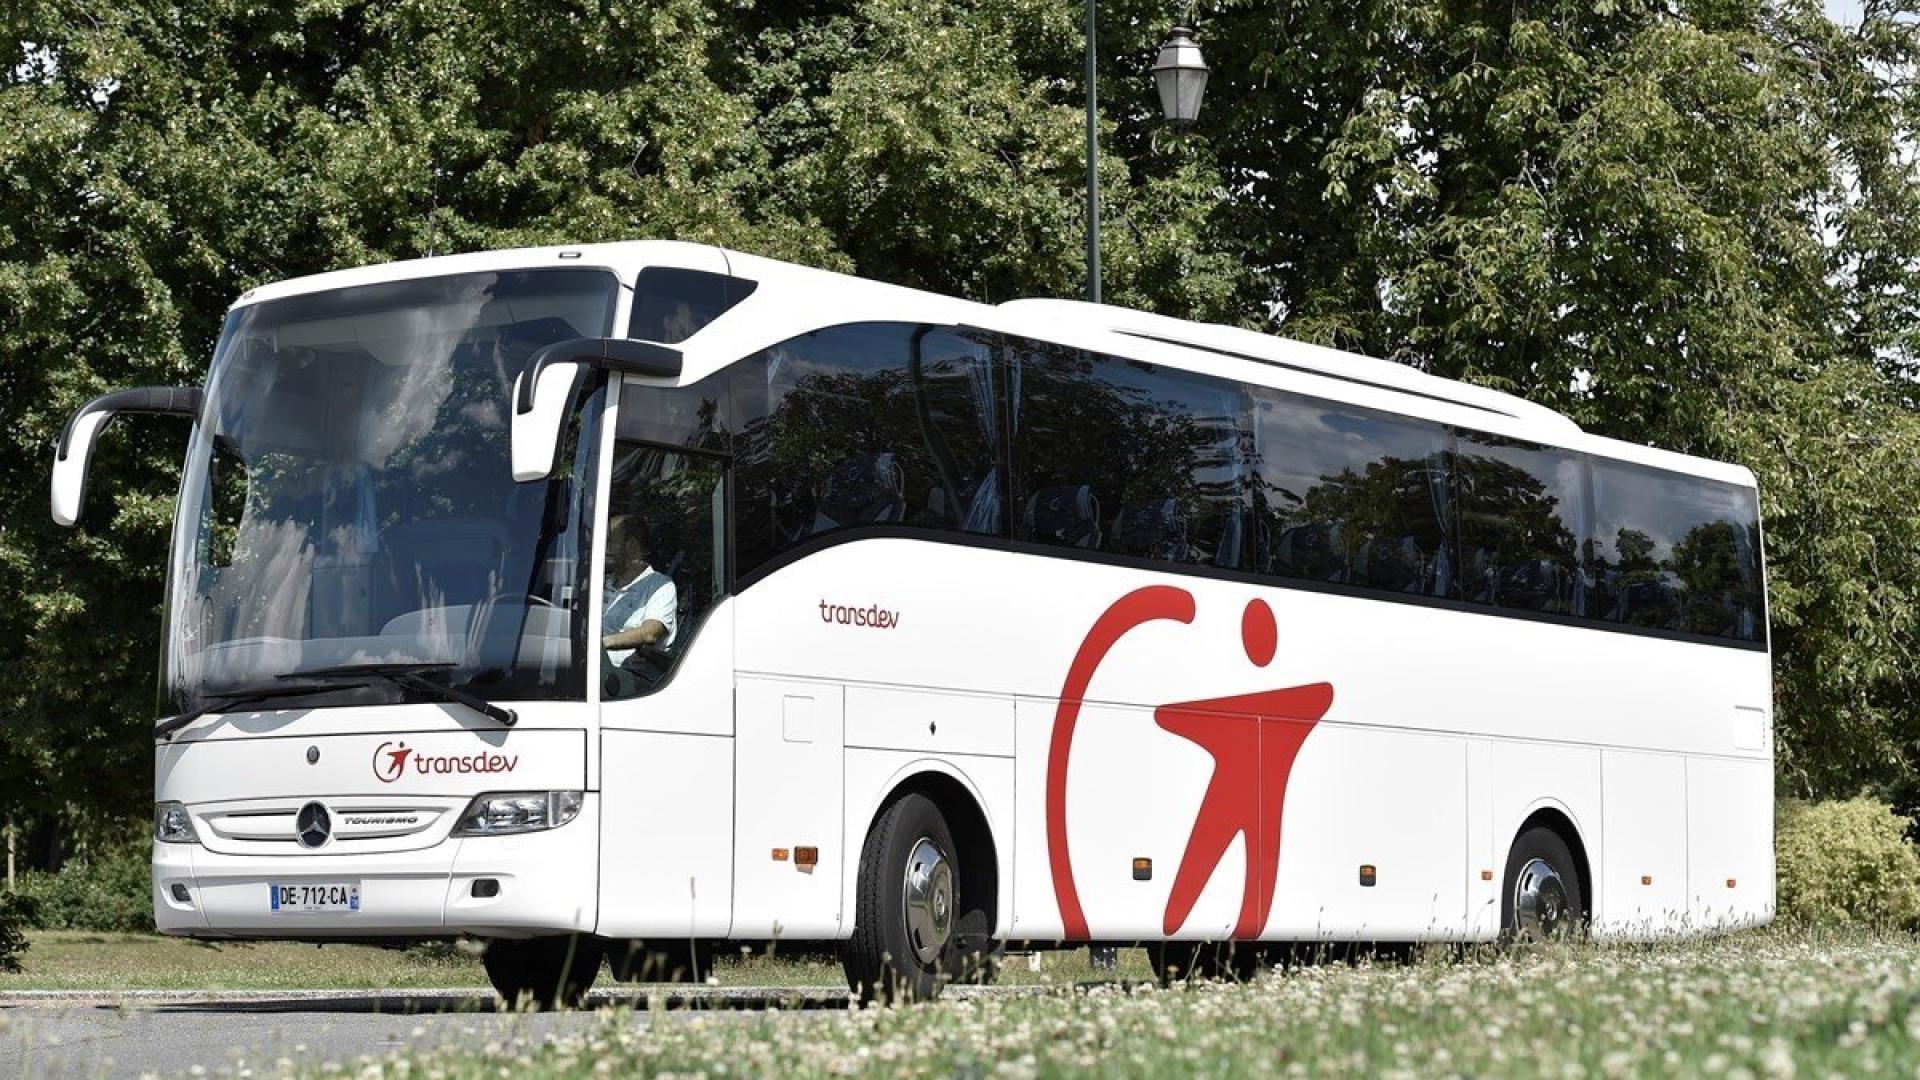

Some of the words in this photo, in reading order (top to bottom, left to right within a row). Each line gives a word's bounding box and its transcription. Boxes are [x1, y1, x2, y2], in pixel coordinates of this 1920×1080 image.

[818, 599, 900, 629] transdev
[414, 751, 518, 774] transdev
[344, 816, 418, 825] TOURISMO
[280, 886, 348, 905] DE-712-CA
